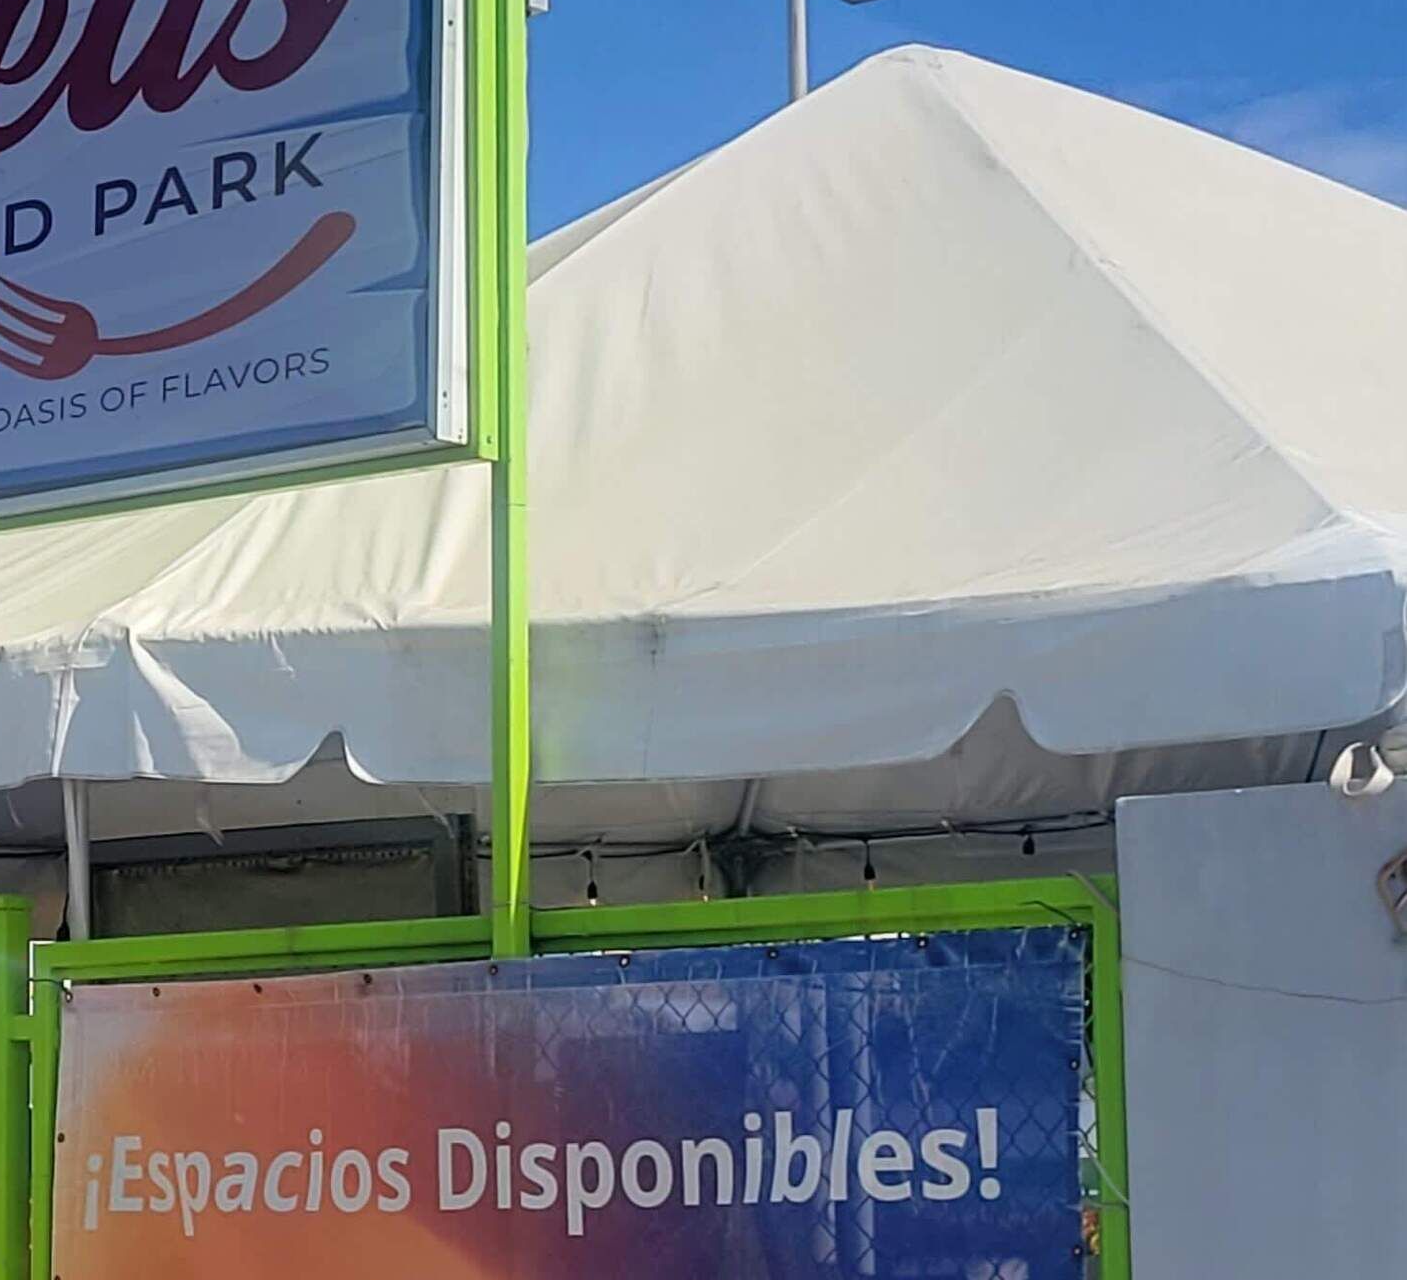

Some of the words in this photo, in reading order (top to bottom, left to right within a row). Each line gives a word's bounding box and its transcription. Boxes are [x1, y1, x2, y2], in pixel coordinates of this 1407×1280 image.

[95, 131, 325, 237] PARK
[99, 380, 146, 413] OF
[161, 345, 332, 400] FLAVORS
[83, 1128, 412, 1236] ¡Espacios
[438, 1108, 1002, 1236] Disponibles!
